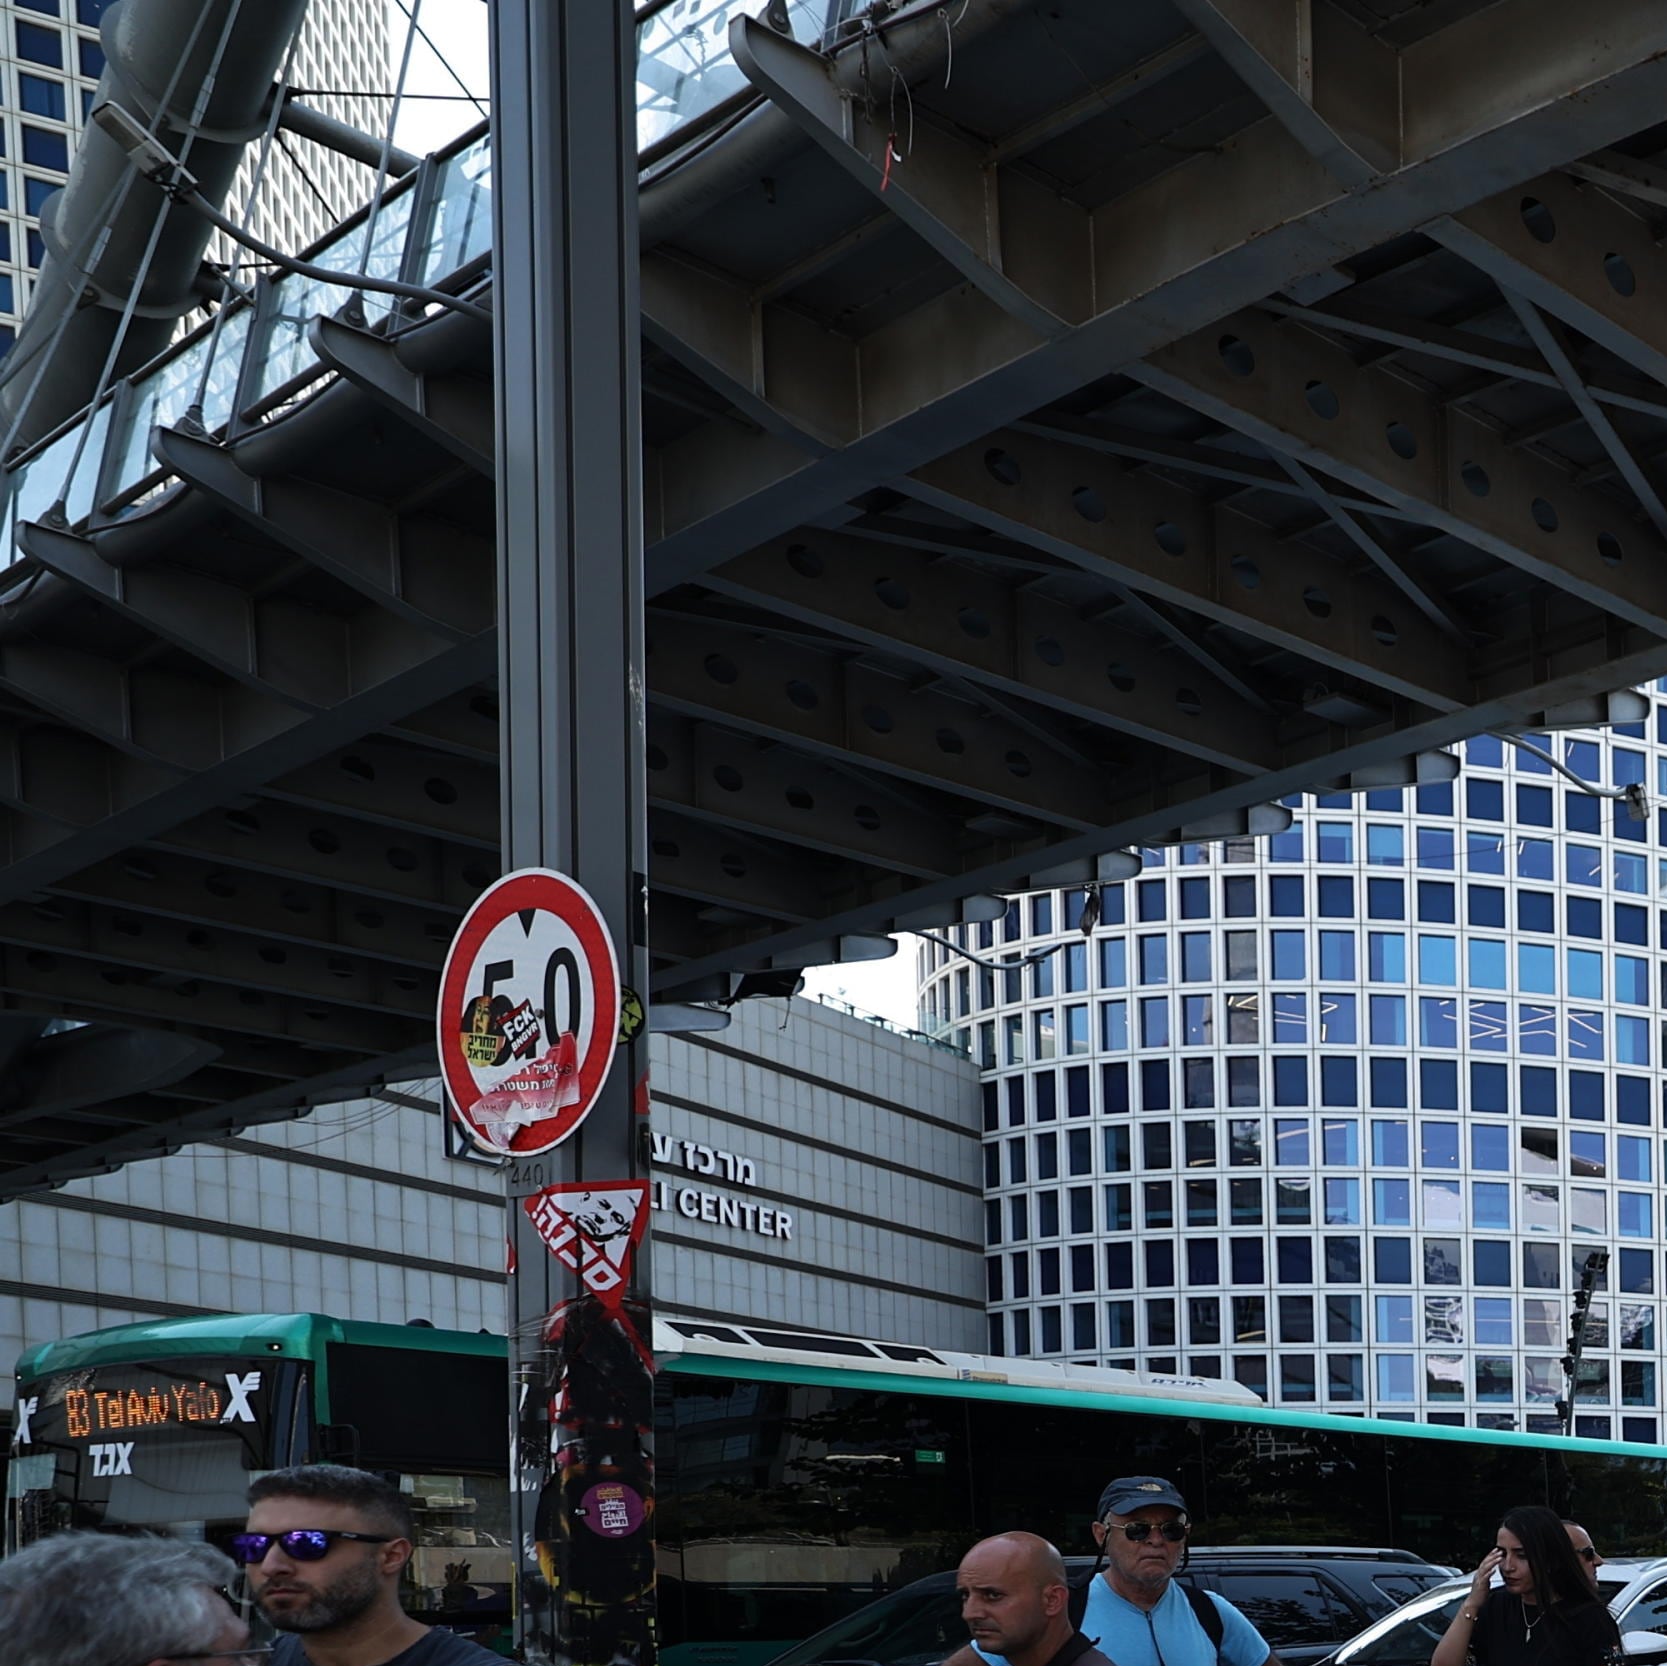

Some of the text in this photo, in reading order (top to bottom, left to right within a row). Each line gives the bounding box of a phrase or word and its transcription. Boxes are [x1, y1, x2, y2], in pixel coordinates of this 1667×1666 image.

[469, 1035, 497, 1045] מחריב
[502, 1005, 535, 1041] FCK
[468, 1047, 496, 1060] ישראל
[511, 1164, 544, 1186] 440
[681, 1141, 756, 1186] מרכז
[680, 1188, 794, 1240] CENTER
[65, 1381, 219, 1437] 83 Tel Aviv Yafo
[89, 1441, 135, 1477] אגד
